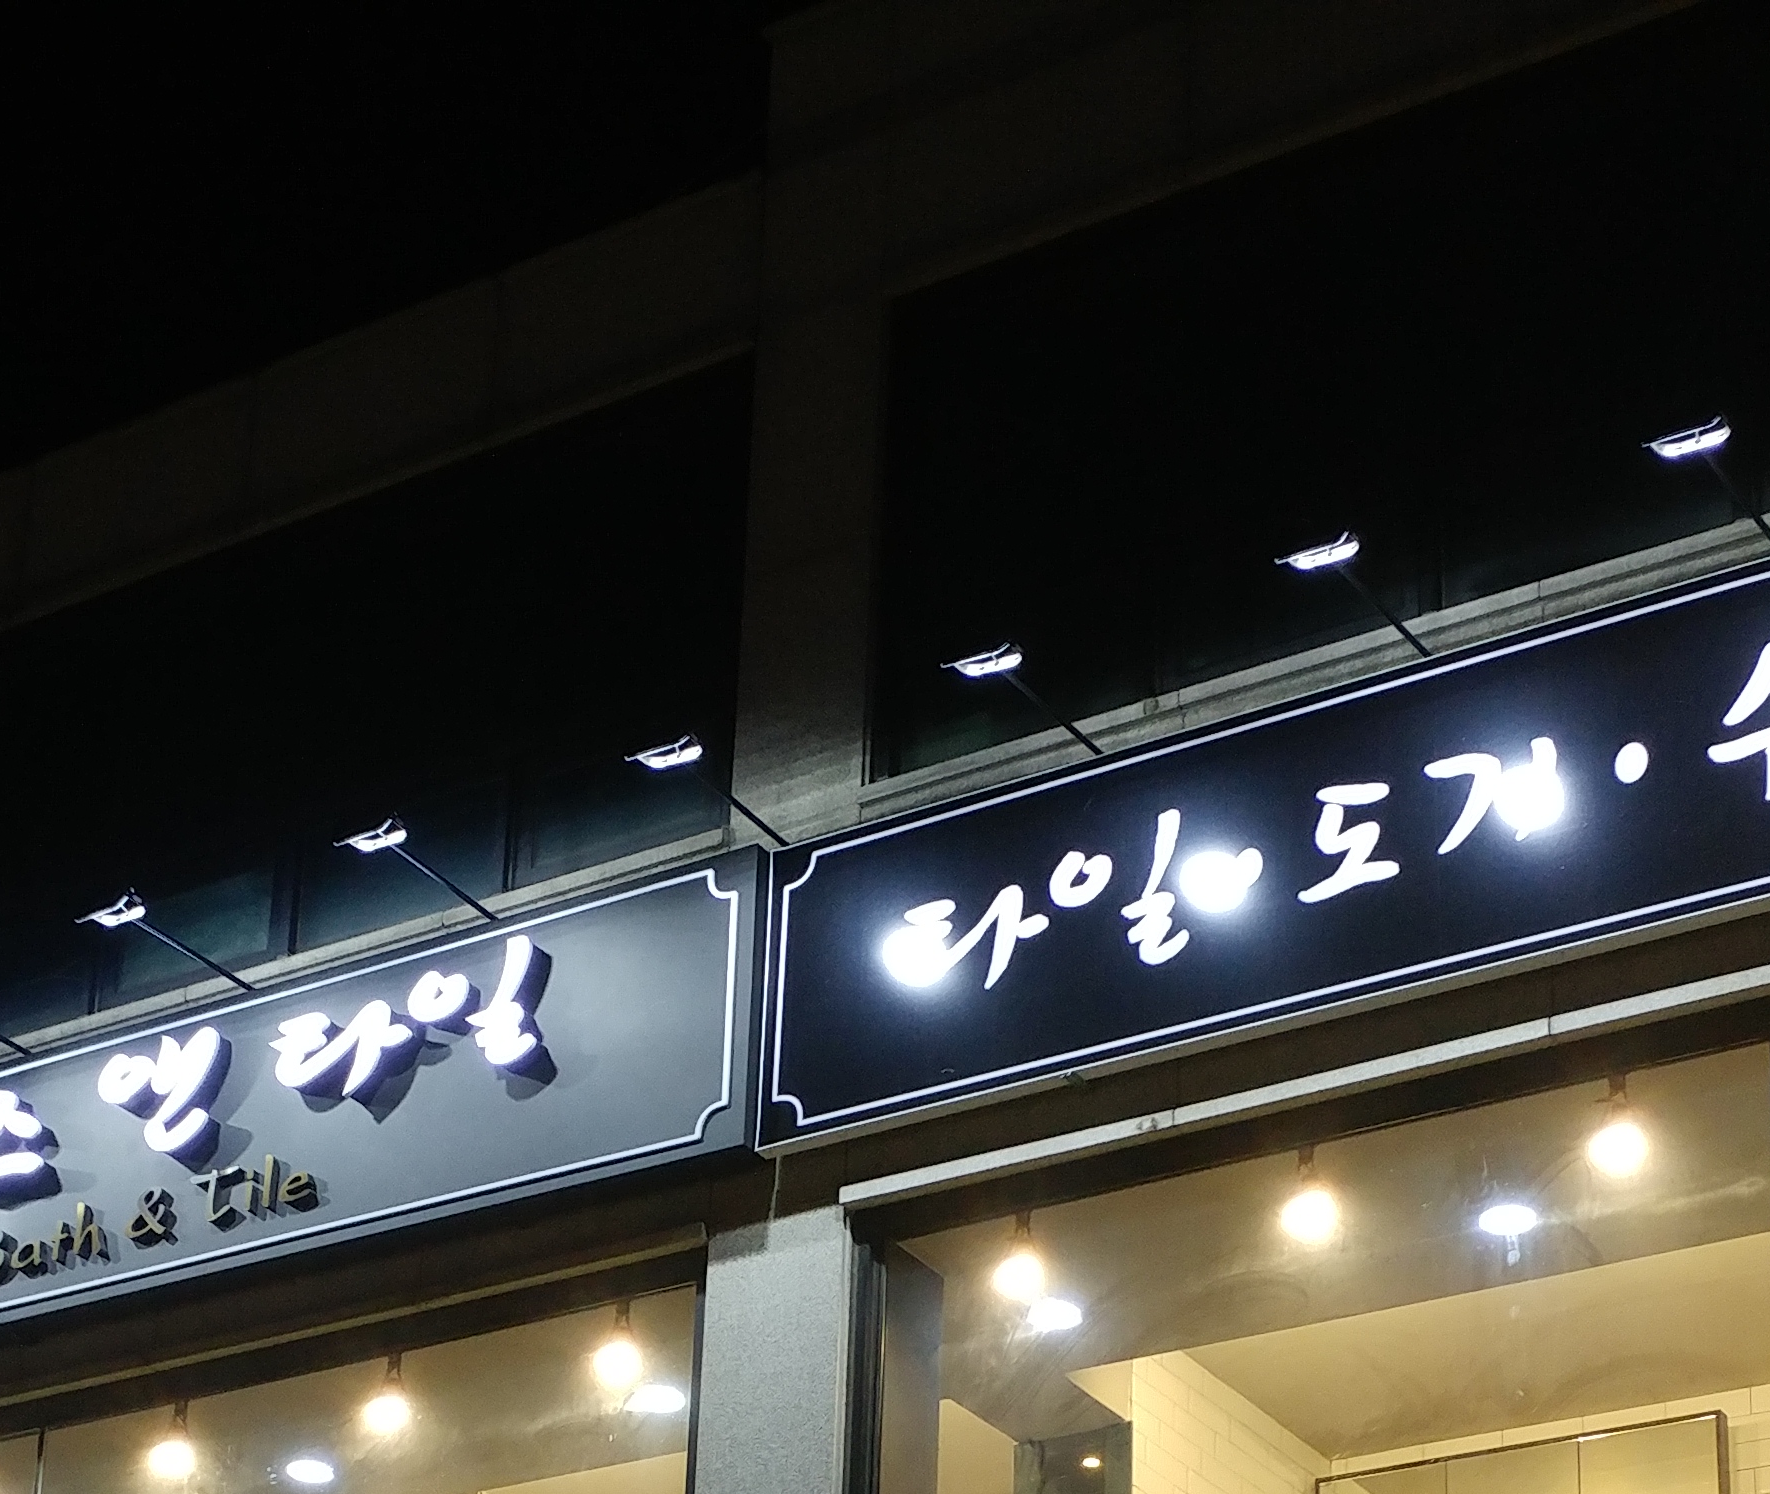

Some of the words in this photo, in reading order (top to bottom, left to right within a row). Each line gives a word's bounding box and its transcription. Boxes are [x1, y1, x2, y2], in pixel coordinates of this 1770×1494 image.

[267, 934, 539, 1097] 타일
[126, 1187, 175, 1243] &
[189, 1154, 316, 1222] Tile
